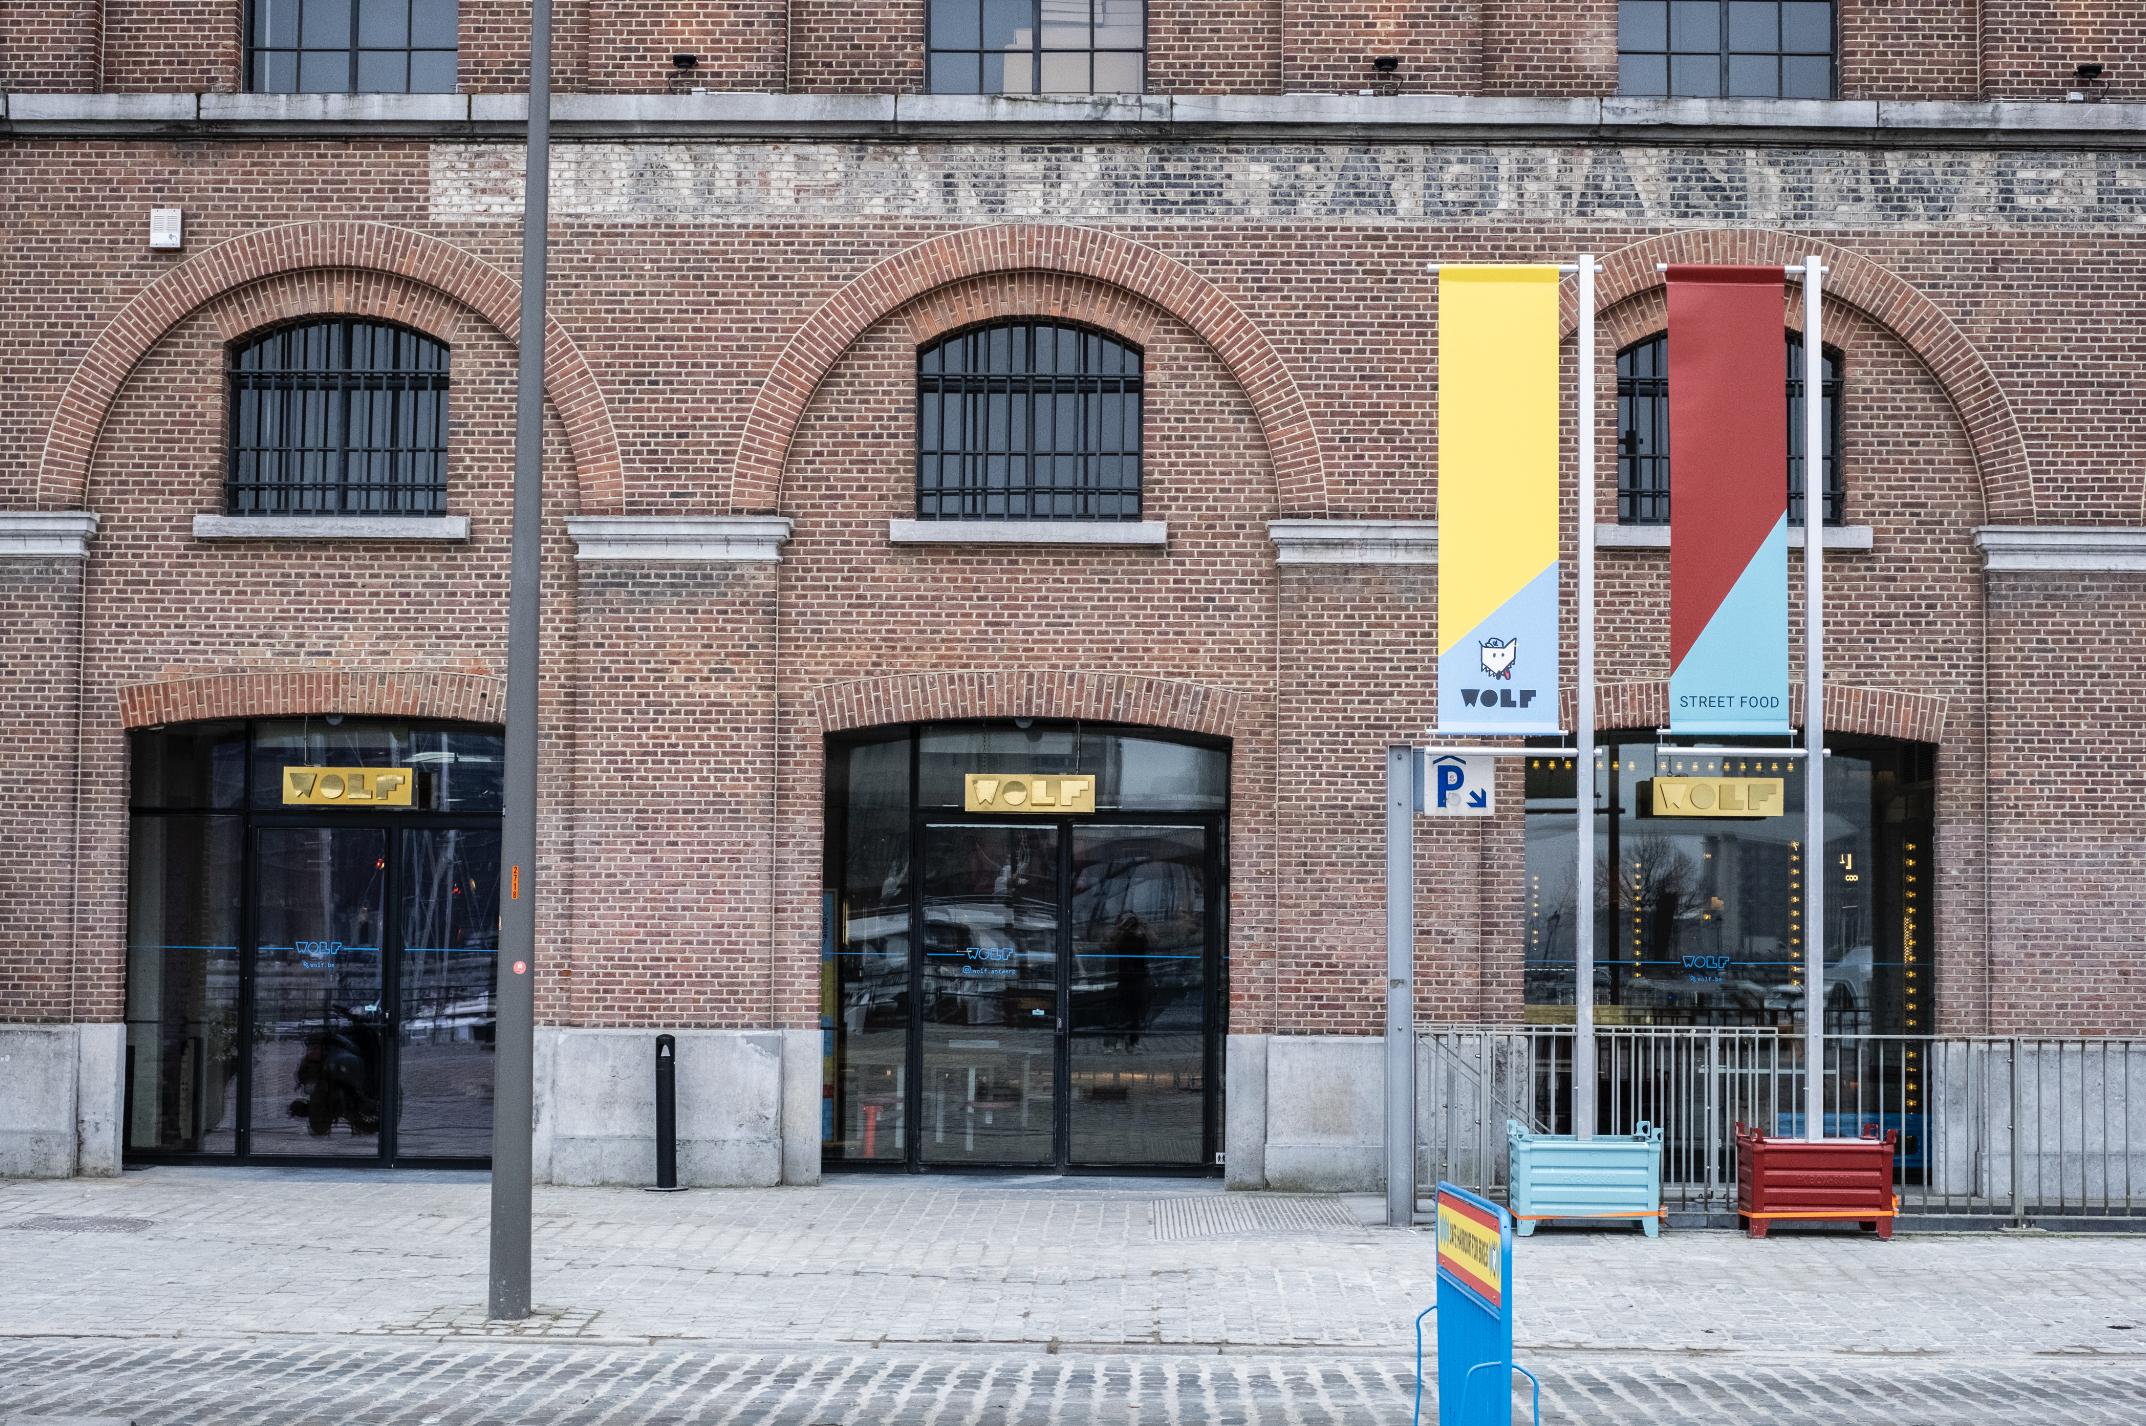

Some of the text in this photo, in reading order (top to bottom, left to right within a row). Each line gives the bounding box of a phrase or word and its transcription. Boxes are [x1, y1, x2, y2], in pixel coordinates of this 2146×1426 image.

[1461, 689, 1536, 708] WOLF
[1680, 695, 1779, 708] STREET FOOD
[289, 772, 405, 800] WOLF
[973, 780, 1089, 806] WOLF
[1438, 765, 1464, 807] P
[1659, 783, 1777, 810] WOLF
[296, 942, 342, 954] WOLF
[966, 948, 1013, 960] WOLF
[1683, 956, 1729, 968] WOLF
